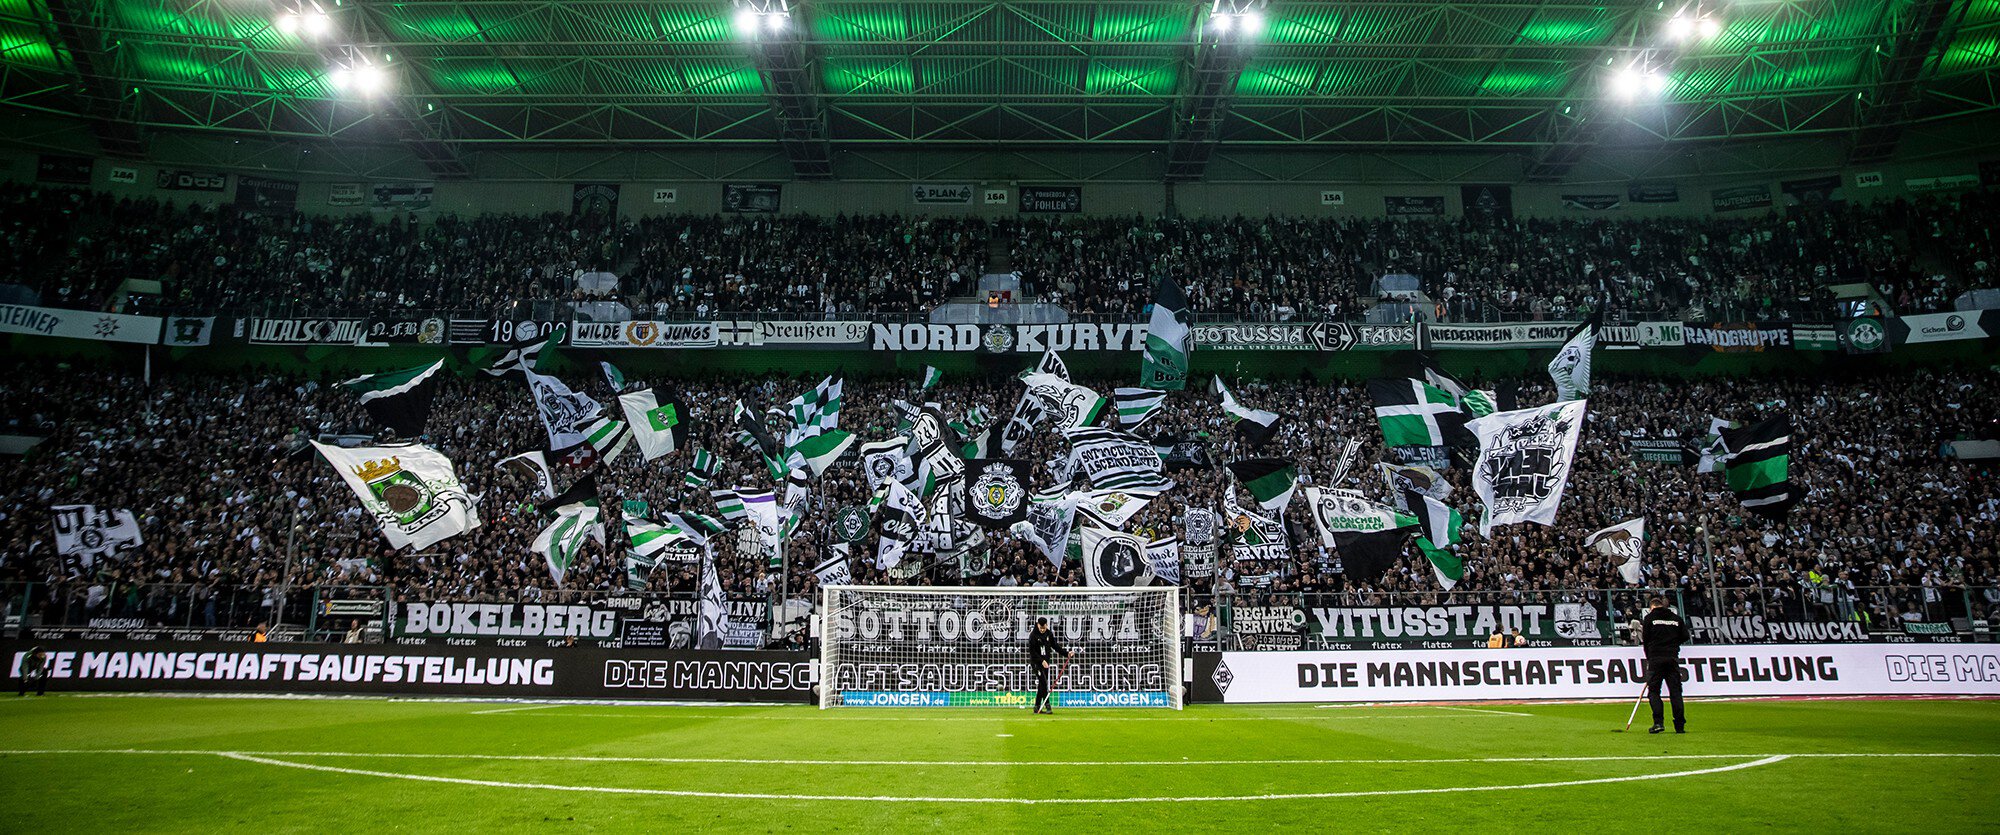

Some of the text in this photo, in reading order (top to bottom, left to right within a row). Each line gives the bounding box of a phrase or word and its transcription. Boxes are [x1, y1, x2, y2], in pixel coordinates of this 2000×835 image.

[113, 171, 134, 180] 18A
[656, 192, 674, 200] 17A
[929, 189, 957, 198] PLAN
[987, 193, 1005, 201] 16A
[252, 318, 315, 342] LOCALS
[577, 324, 711, 340] WILDE JUNGS
[1193, 325, 1307, 345] BORUSSIA
[1357, 325, 1416, 345] FANS
[1430, 328, 1513, 342] NIEDERRHEIN
[1660, 325, 1681, 342] MG
[1683, 326, 1790, 347] RANDGRUPPE
[1921, 326, 1946, 335] Cichon
[873, 323, 1149, 352] NORD KURVE
[1087, 456, 1160, 476] ASCENDENTE
[1330, 515, 1382, 524] MÖNCHEN
[1332, 522, 1385, 531] GLADBACH
[405, 600, 616, 637] BÖKELBERG
[1232, 606, 1294, 621] BEGLEIT
[1232, 620, 1293, 634] SERVICE
[1312, 605, 1547, 638] VITUSSTADT
[1689, 615, 1766, 639] PINKIS
[1767, 621, 1870, 642] PUMUCKL
[396, 636, 427, 645] flatex
[446, 637, 476, 646] flatex
[496, 637, 528, 647] flatex
[981, 643, 1021, 652] flatex
[1372, 641, 1402, 650] flatex
[1422, 640, 1453, 649] flatex
[1571, 638, 1602, 647] flatex
[1112, 643, 1152, 653] flatex
[78, 651, 555, 686] MANNSCHAFTSAUFSTELLUNG
[603, 659, 668, 689] DIE
[1885, 654, 1951, 682] DIE
[1297, 662, 1360, 689] DIE
[869, 693, 931, 705] JONGEN
[1088, 693, 1150, 705] JONGEN
